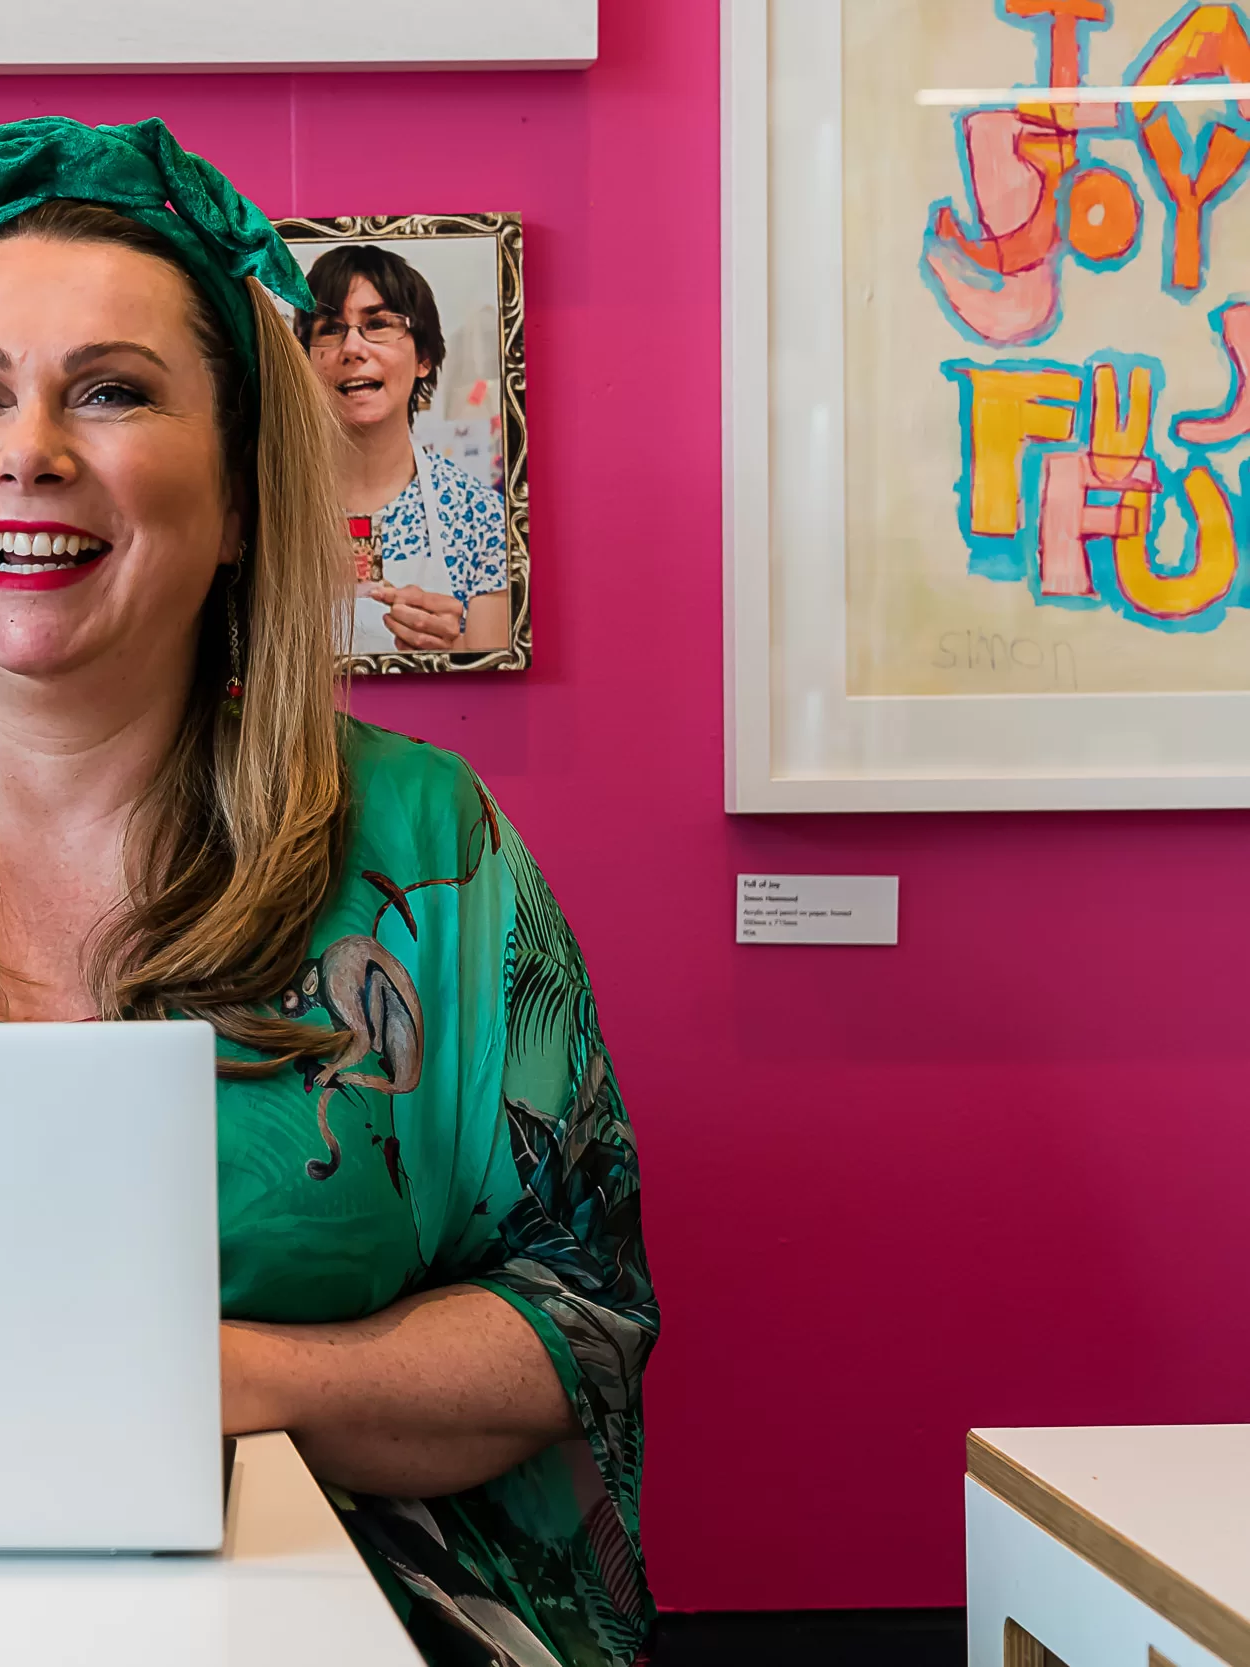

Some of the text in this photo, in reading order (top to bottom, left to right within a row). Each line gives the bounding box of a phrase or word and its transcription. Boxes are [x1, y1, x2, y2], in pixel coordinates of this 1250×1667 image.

[744, 880, 756, 888] Full
[758, 880, 767, 888] of
[765, 908, 778, 916] and
